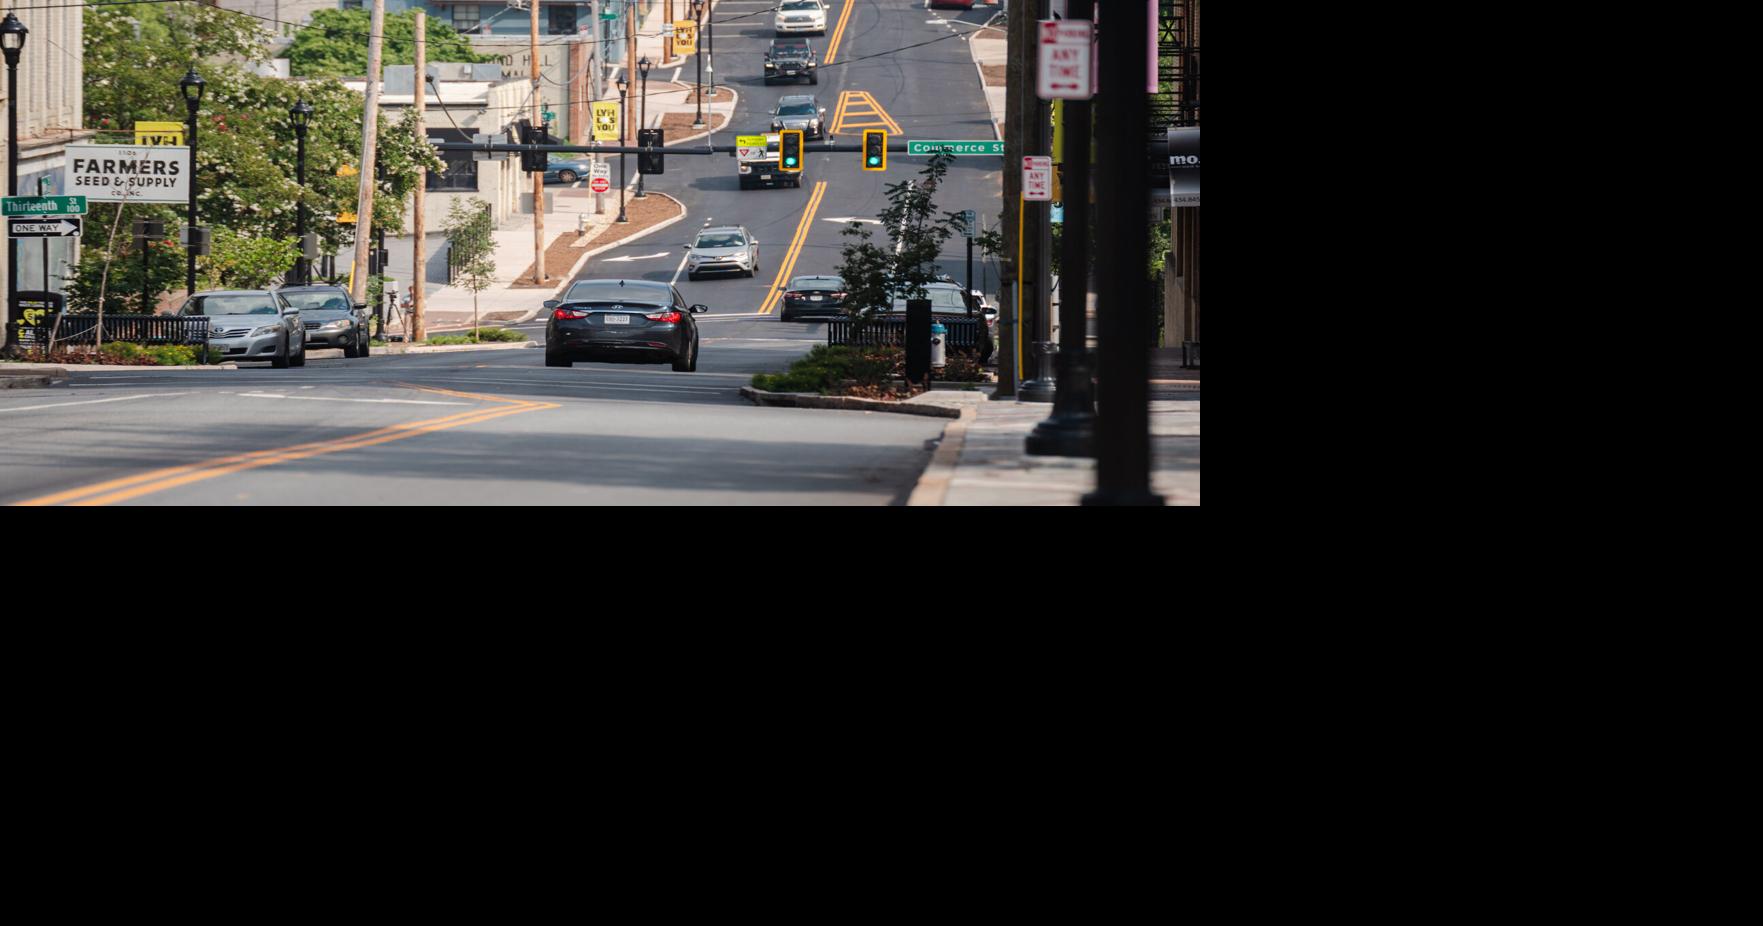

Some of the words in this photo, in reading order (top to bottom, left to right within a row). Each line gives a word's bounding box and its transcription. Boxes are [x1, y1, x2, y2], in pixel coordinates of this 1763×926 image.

[1053, 48, 1078, 59] ANY
[597, 109, 615, 117] LYH
[73, 159, 180, 175] FARMERS
[1029, 172, 1044, 180] ANY
[75, 176, 110, 186] SEED
[114, 177, 124, 187] &
[129, 177, 177, 187] SUPPLY
[1028, 181, 1045, 190] TIME
[6, 200, 58, 212] Thirteenth
[67, 205, 80, 213] 100
[15, 224, 35, 232] ONE
[38, 224, 59, 232] WAY
